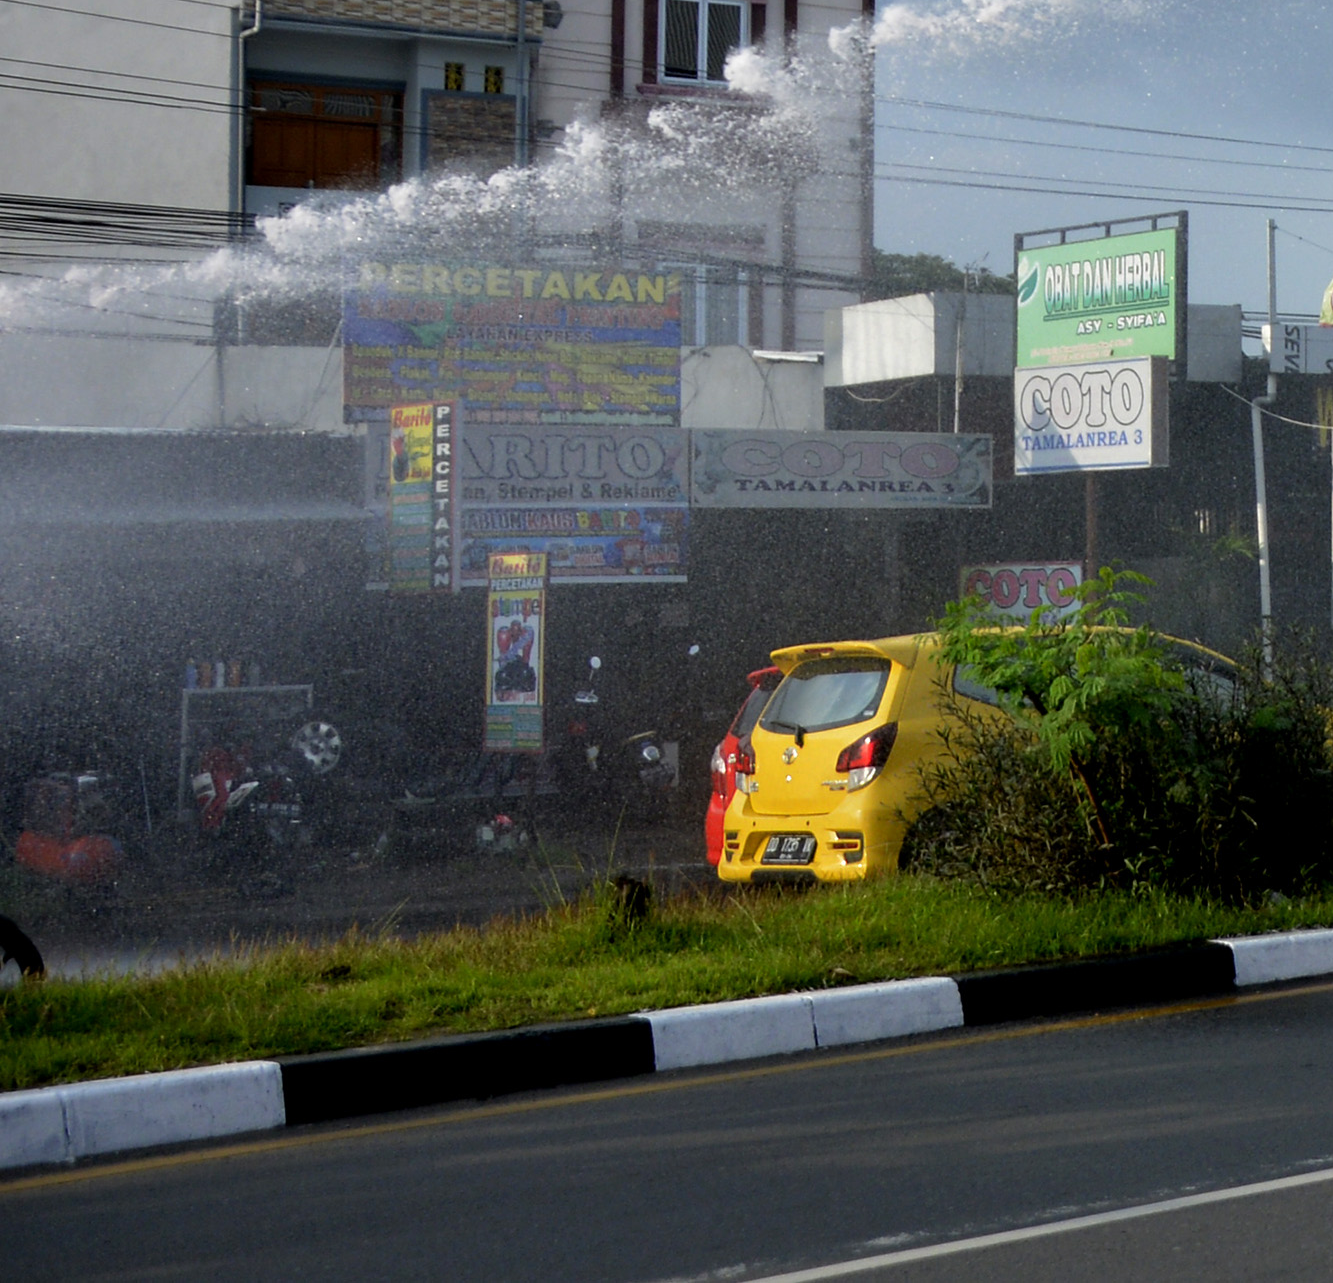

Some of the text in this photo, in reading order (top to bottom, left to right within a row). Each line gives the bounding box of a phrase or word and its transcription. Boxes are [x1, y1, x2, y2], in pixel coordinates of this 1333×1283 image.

[359, 262, 664, 303] PERCETAKAN
[1044, 248, 1170, 315] OBAT DAN HERBAL
[1076, 318, 1103, 335] ASY
[1021, 368, 1144, 431] COTO
[1022, 429, 1143, 451] TAMALANREA 3
[721, 439, 961, 479] COTO
[499, 482, 575, 503] Stempel
[581, 483, 595, 500] &
[735, 479, 955, 494] TAMALANREA 3
[576, 511, 641, 530] BARITO
[966, 567, 1077, 609] COTO
